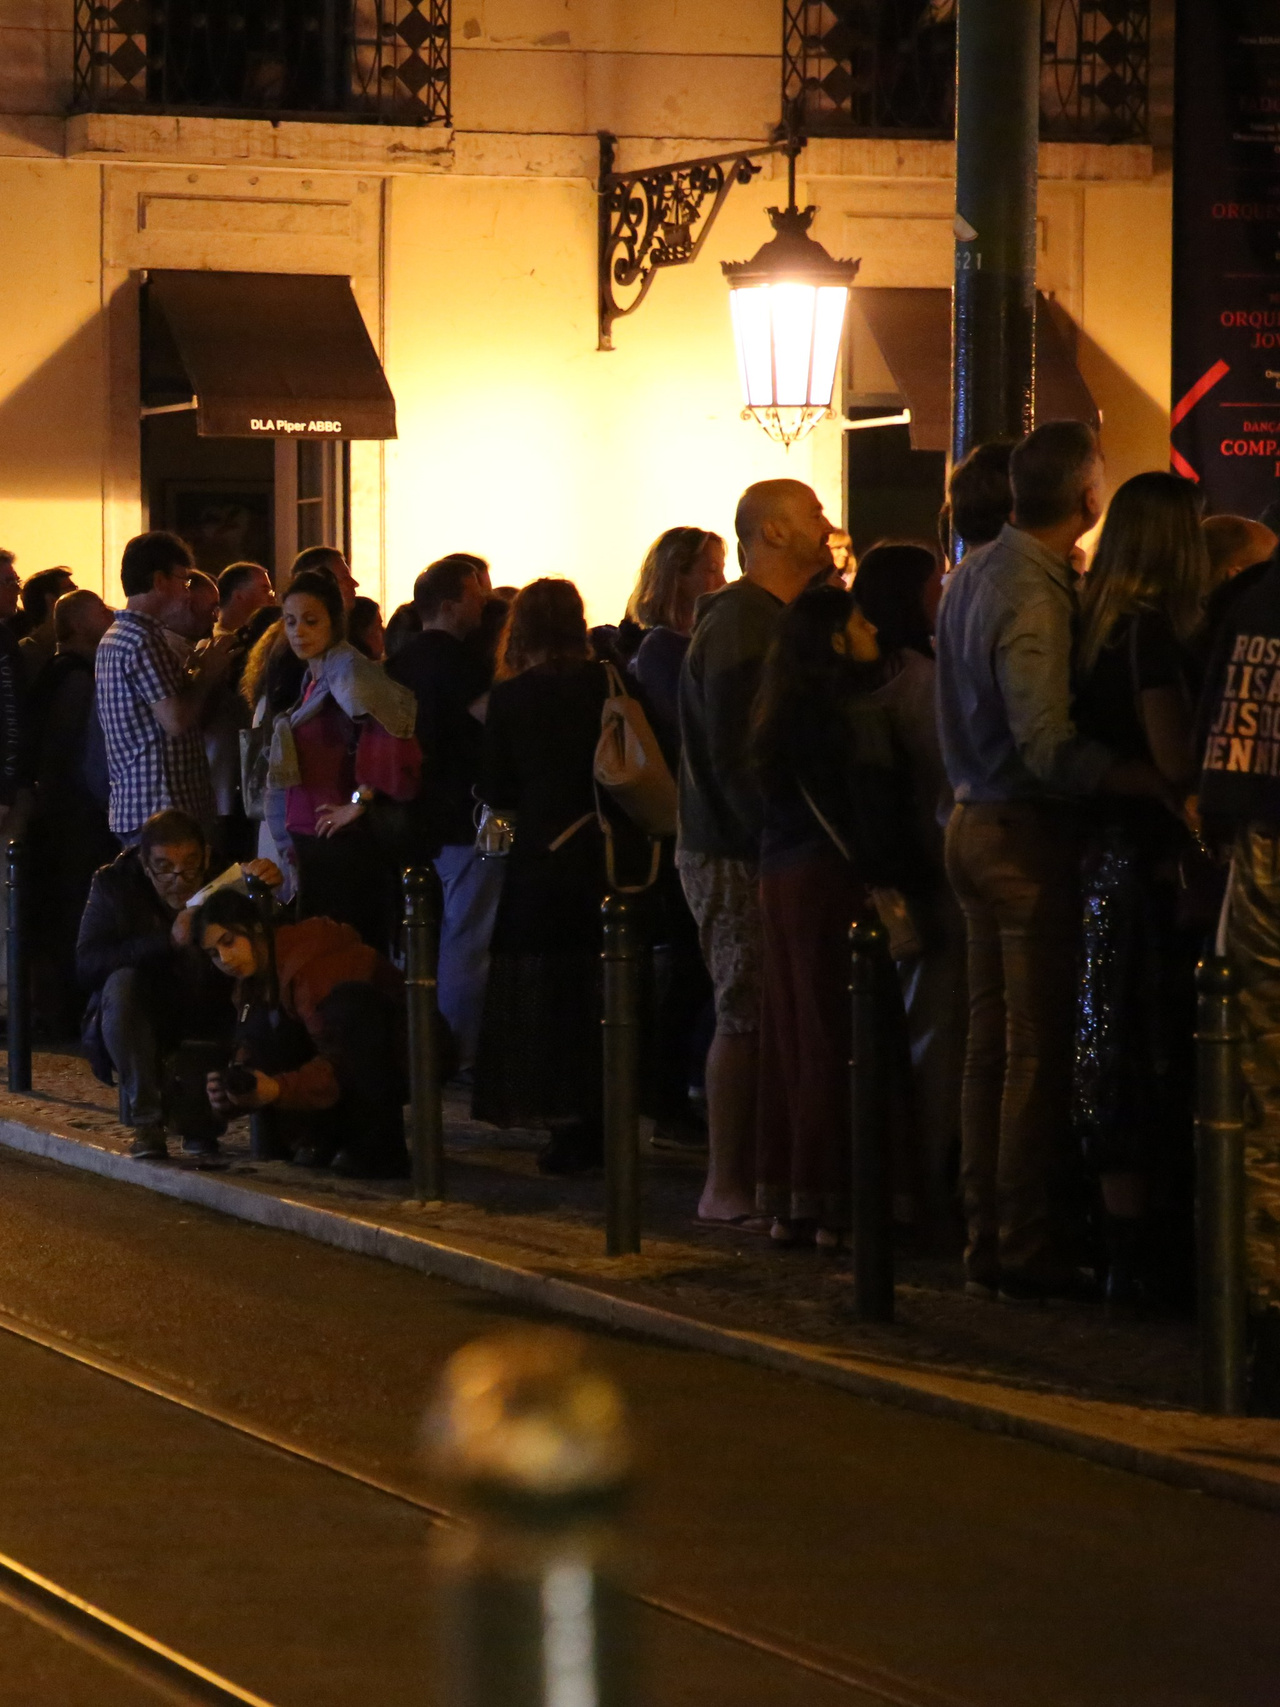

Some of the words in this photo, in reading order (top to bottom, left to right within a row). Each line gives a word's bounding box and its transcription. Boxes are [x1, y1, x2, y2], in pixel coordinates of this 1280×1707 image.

[250, 419, 275, 431] DLA
[276, 420, 307, 433] Piper
[308, 421, 342, 432] ABBC
